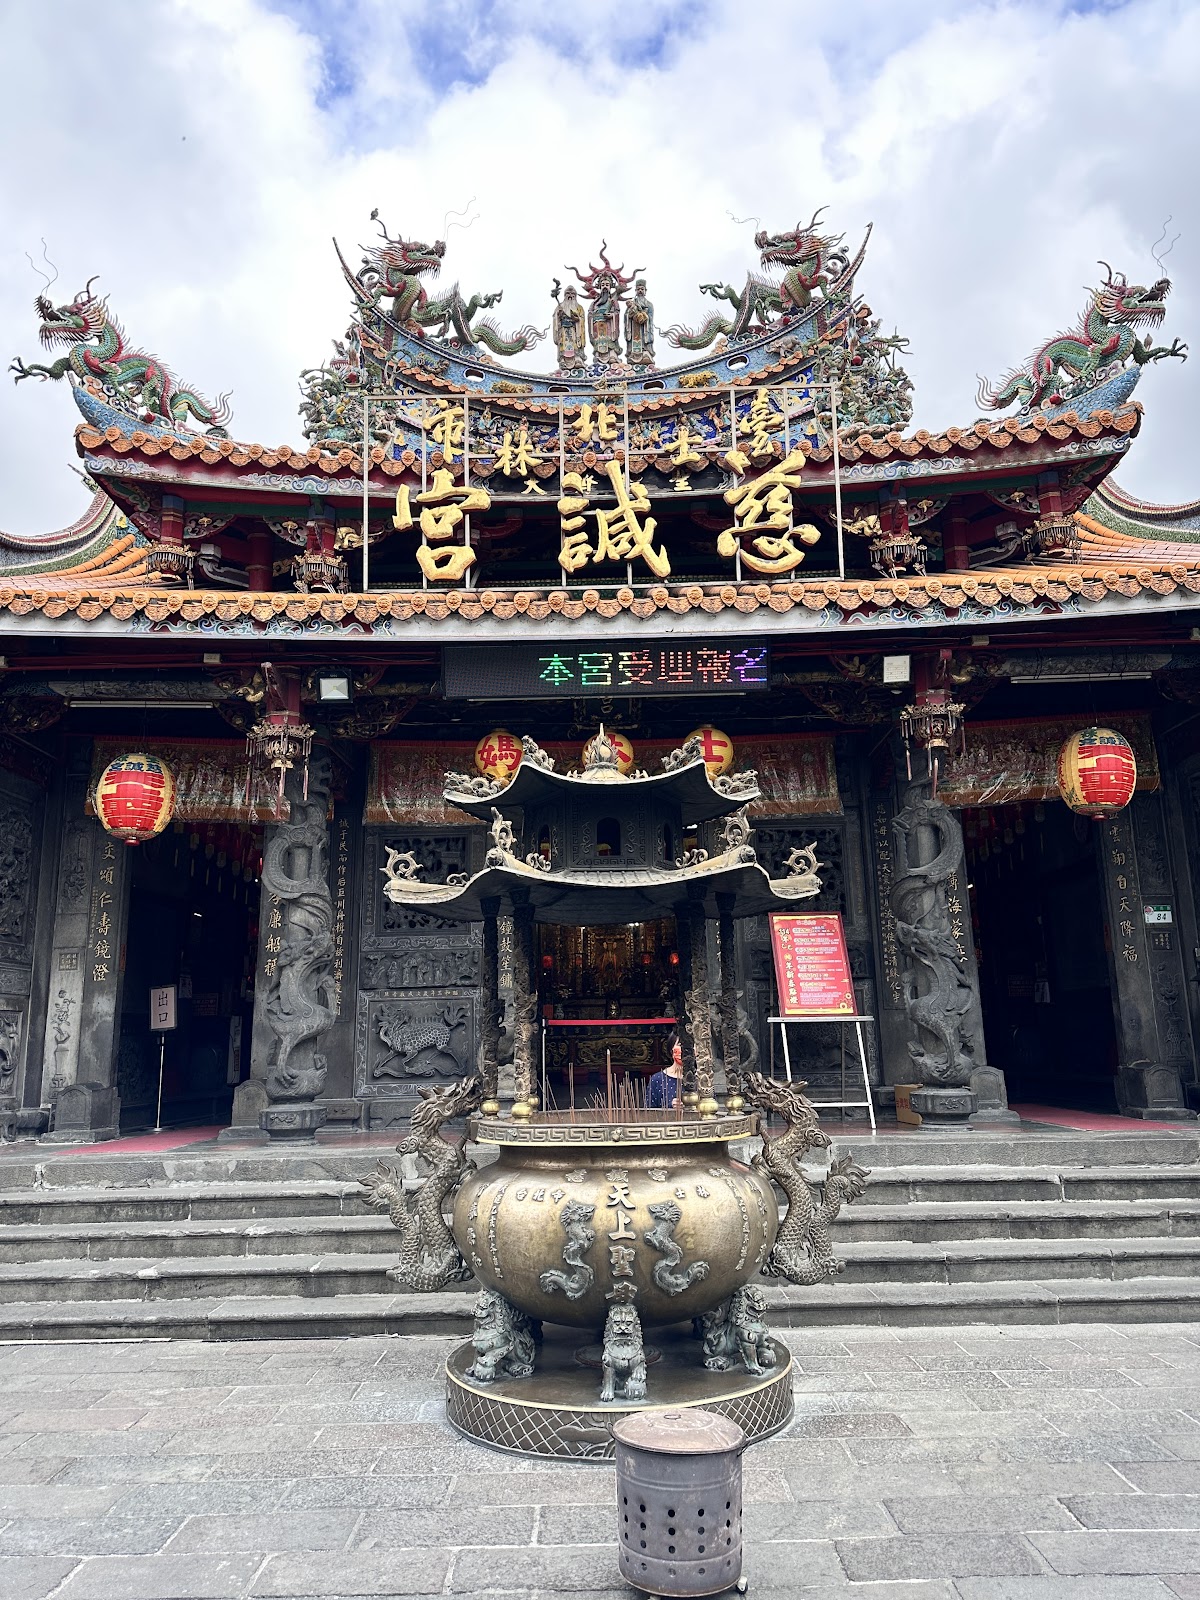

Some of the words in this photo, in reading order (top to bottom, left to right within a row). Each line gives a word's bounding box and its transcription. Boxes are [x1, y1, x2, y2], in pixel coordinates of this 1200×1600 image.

[478, 735, 523, 772] 媽
[1157, 913, 1166, 921] 84
[158, 990, 169, 1023] 出口
[515, 1187, 565, 1204] 台北市
[675, 1186, 710, 1200] 士林
[606, 1184, 639, 1303] 天上聖母
